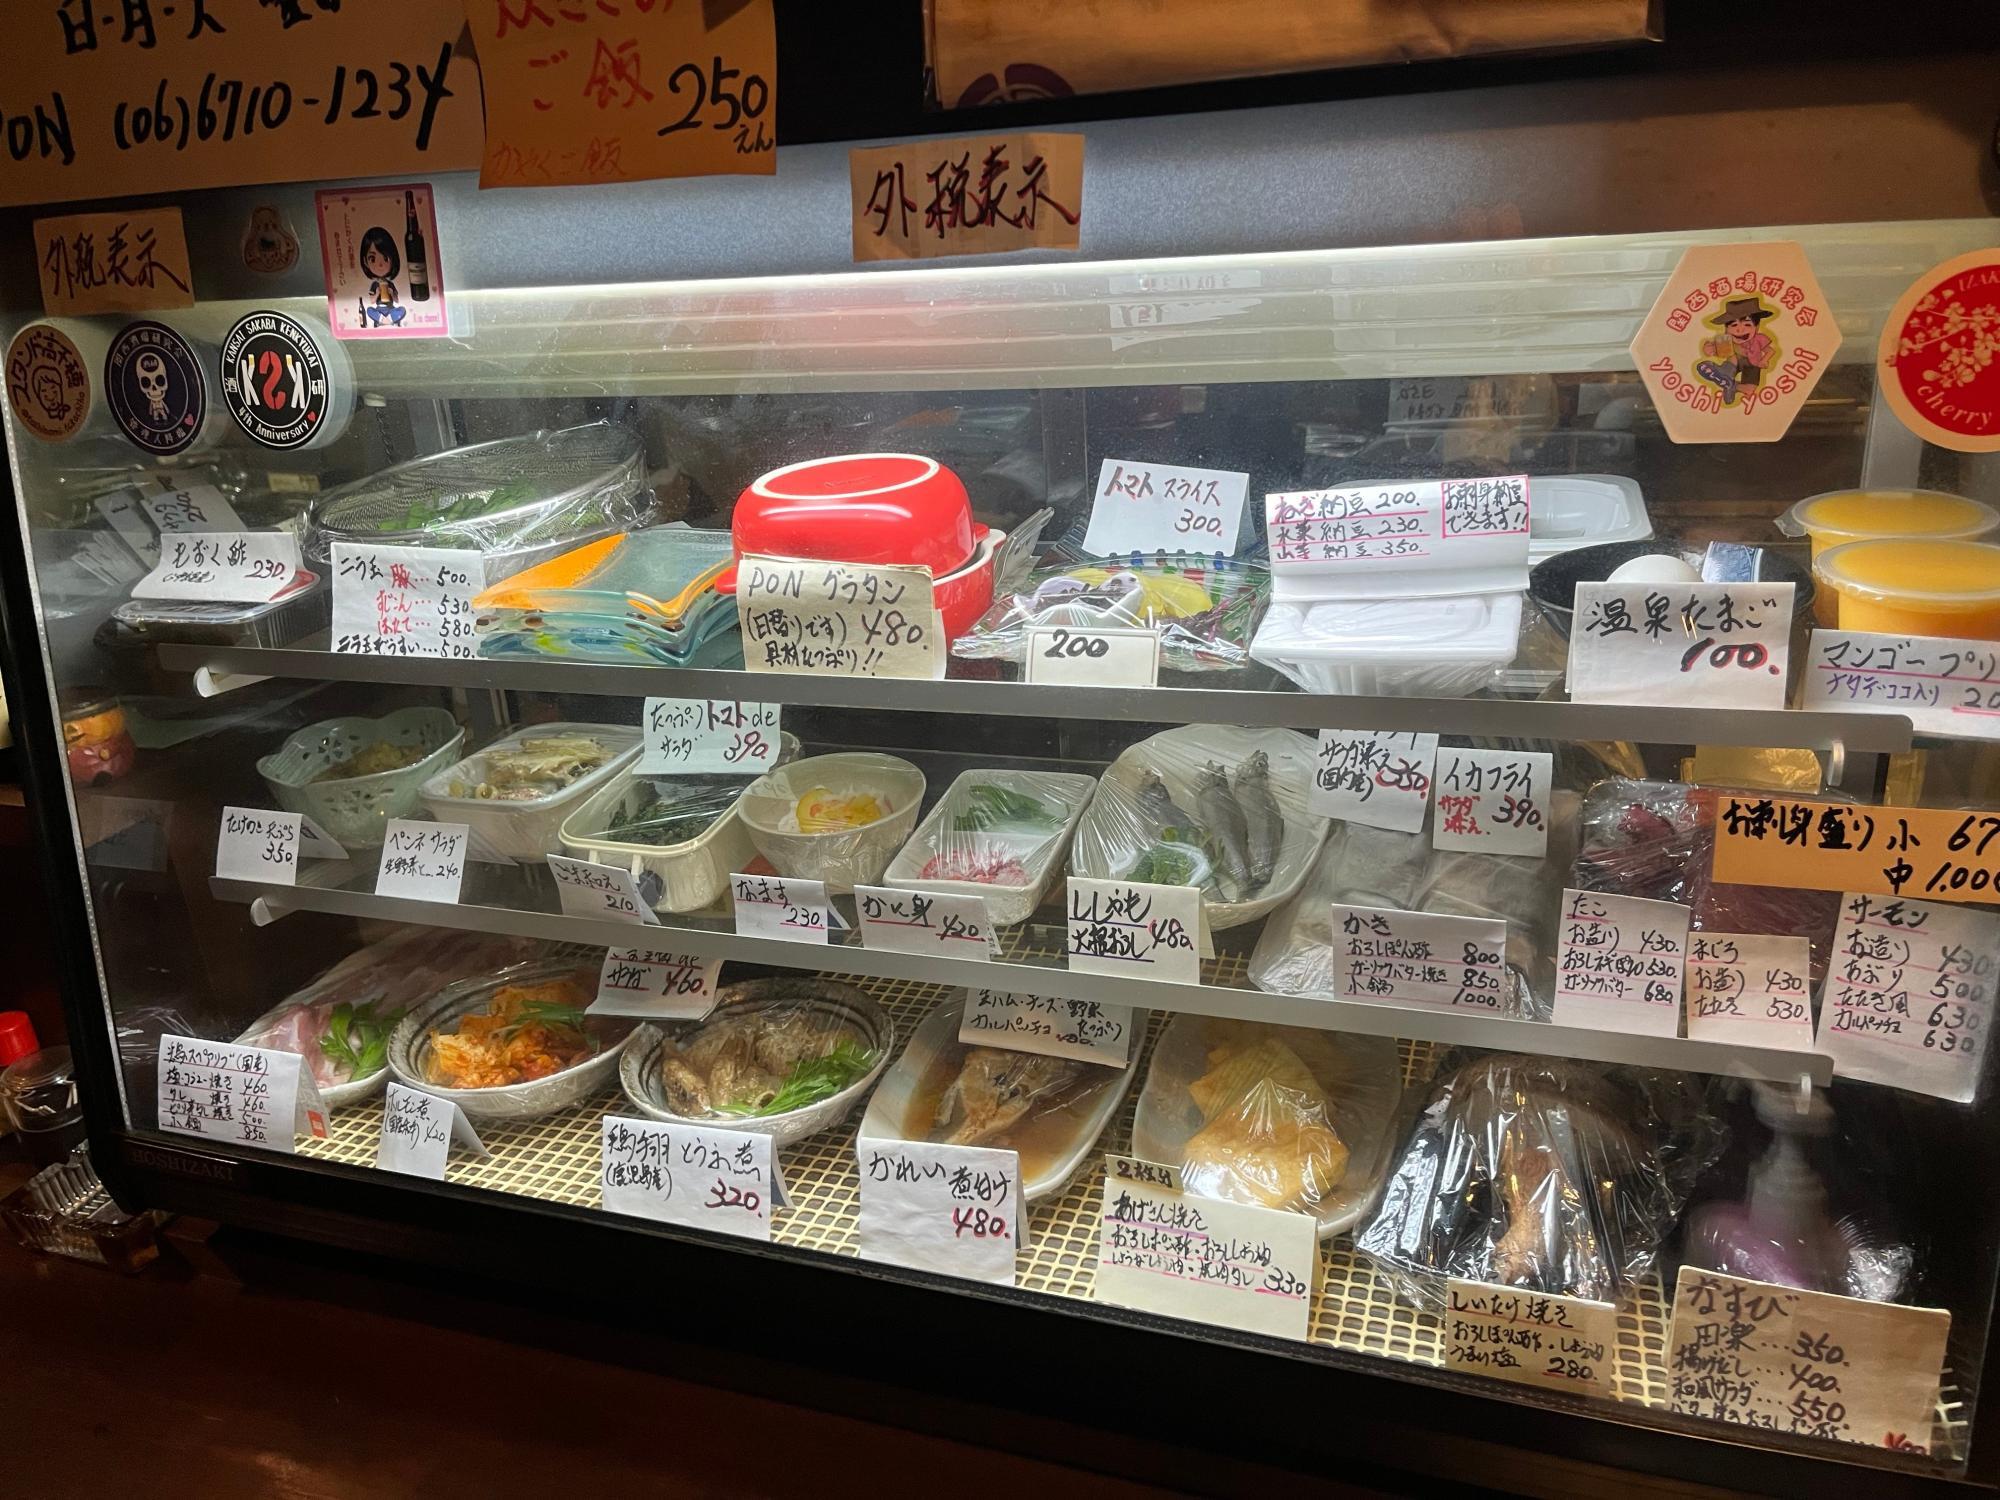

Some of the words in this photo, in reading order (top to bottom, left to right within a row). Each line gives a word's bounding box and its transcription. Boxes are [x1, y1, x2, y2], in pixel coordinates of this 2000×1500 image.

[656, 55, 770, 136] 250
[0, 90, 77, 166] ON
[733, 121, 774, 155] えん
[863, 144, 1082, 239] 外税表示
[45, 222, 190, 300] 外税表示
[225, 330, 246, 364] KANSAI
[245, 317, 277, 335] SAKABA
[279, 321, 320, 368] KENKYUKAI
[238, 406, 253, 427] 4th
[255, 419, 310, 441] Anniversary
[1917, 385, 1994, 431] cherry
[1104, 466, 1154, 500] トマト
[1164, 477, 1221, 507] スライス
[1375, 490, 1420, 510] 200.
[1174, 508, 1223, 536] 300.
[1378, 518, 1423, 536] 230.
[436, 565, 471, 587] 500.
[748, 566, 803, 598] PON
[822, 567, 906, 605] グラタン
[437, 593, 475, 615] 530.
[1585, 591, 1778, 638] 温泉たまご
[439, 617, 475, 638] 580.
[861, 608, 928, 650] 480.
[1043, 628, 1109, 658] 200
[440, 639, 475, 659] 500.
[1679, 637, 1780, 675] 100.
[1443, 756, 1533, 798] イカフライ
[1491, 794, 1545, 832] 390.
[1886, 818, 1921, 852] 小
[261, 840, 294, 866] 350.
[1883, 857, 1914, 895] 中
[605, 894, 638, 914] 210.
[736, 880, 790, 908] なます
[1572, 892, 1607, 919] たこ
[785, 908, 824, 928] 230.
[1343, 911, 1392, 936] かき
[1848, 895, 1929, 929] サーモン
[1462, 942, 1503, 969] 800.
[1641, 929, 1680, 955] 430.
[1691, 938, 1739, 965] まぐろ
[1846, 928, 1911, 968] お造り
[1461, 968, 1501, 993] 850.
[1645, 957, 1678, 979] 530.
[1765, 968, 1806, 995] 430.
[1844, 958, 1904, 993] あぶり
[1929, 973, 1985, 1001] 500
[1451, 987, 1502, 1009] 1000.
[1766, 998, 1809, 1021] 530.
[1927, 1001, 1980, 1031] 630
[1922, 1029, 1976, 1053] 630
[703, 1177, 763, 1219] 320.
[951, 1206, 1011, 1241] 480.
[1263, 1265, 1308, 1300] 330.
[1686, 1275, 1800, 1322] なすび
[1546, 1356, 1599, 1381] 280.
[1787, 1390, 1850, 1430] 550.
